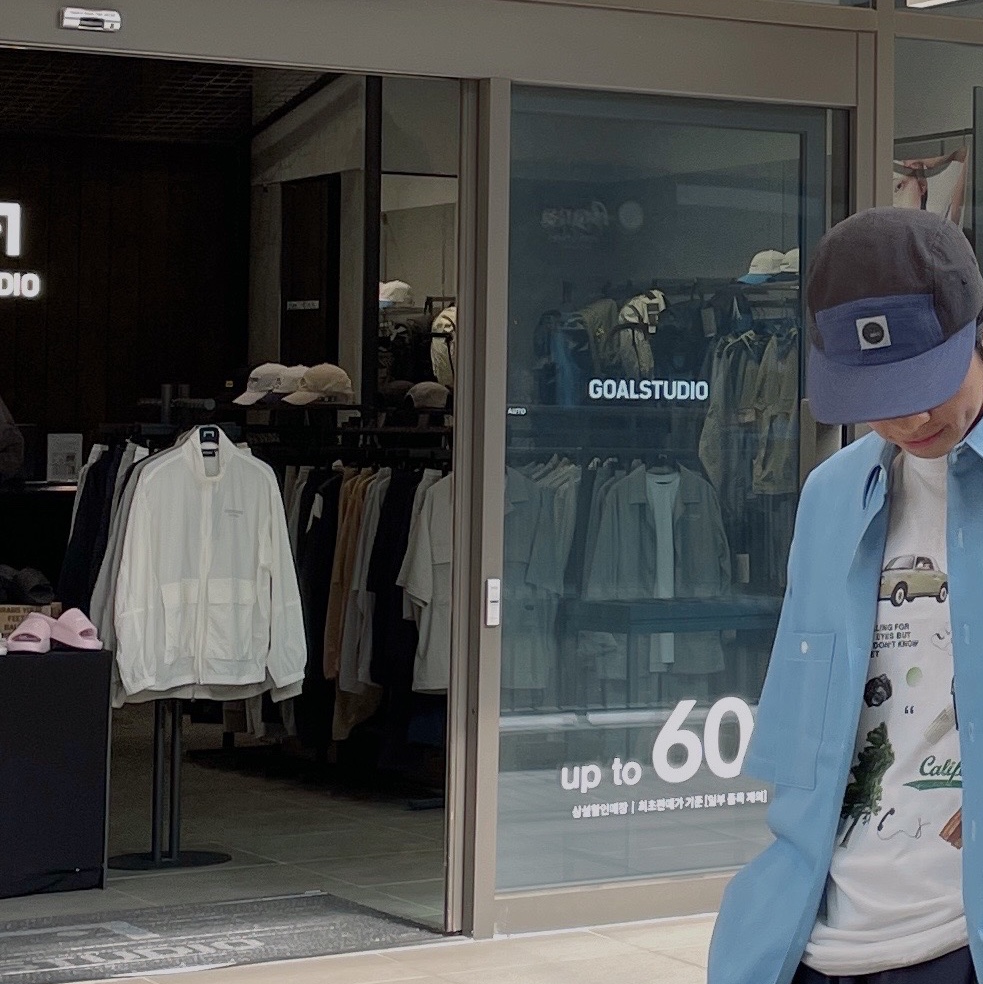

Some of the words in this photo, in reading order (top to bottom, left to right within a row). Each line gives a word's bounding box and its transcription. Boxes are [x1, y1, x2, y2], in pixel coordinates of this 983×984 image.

[588, 379, 709, 400] GOALSTUDIO
[895, 622, 910, 630] FOR
[561, 764, 602, 793] up
[611, 757, 643, 786] to
[652, 697, 755, 783] 60
